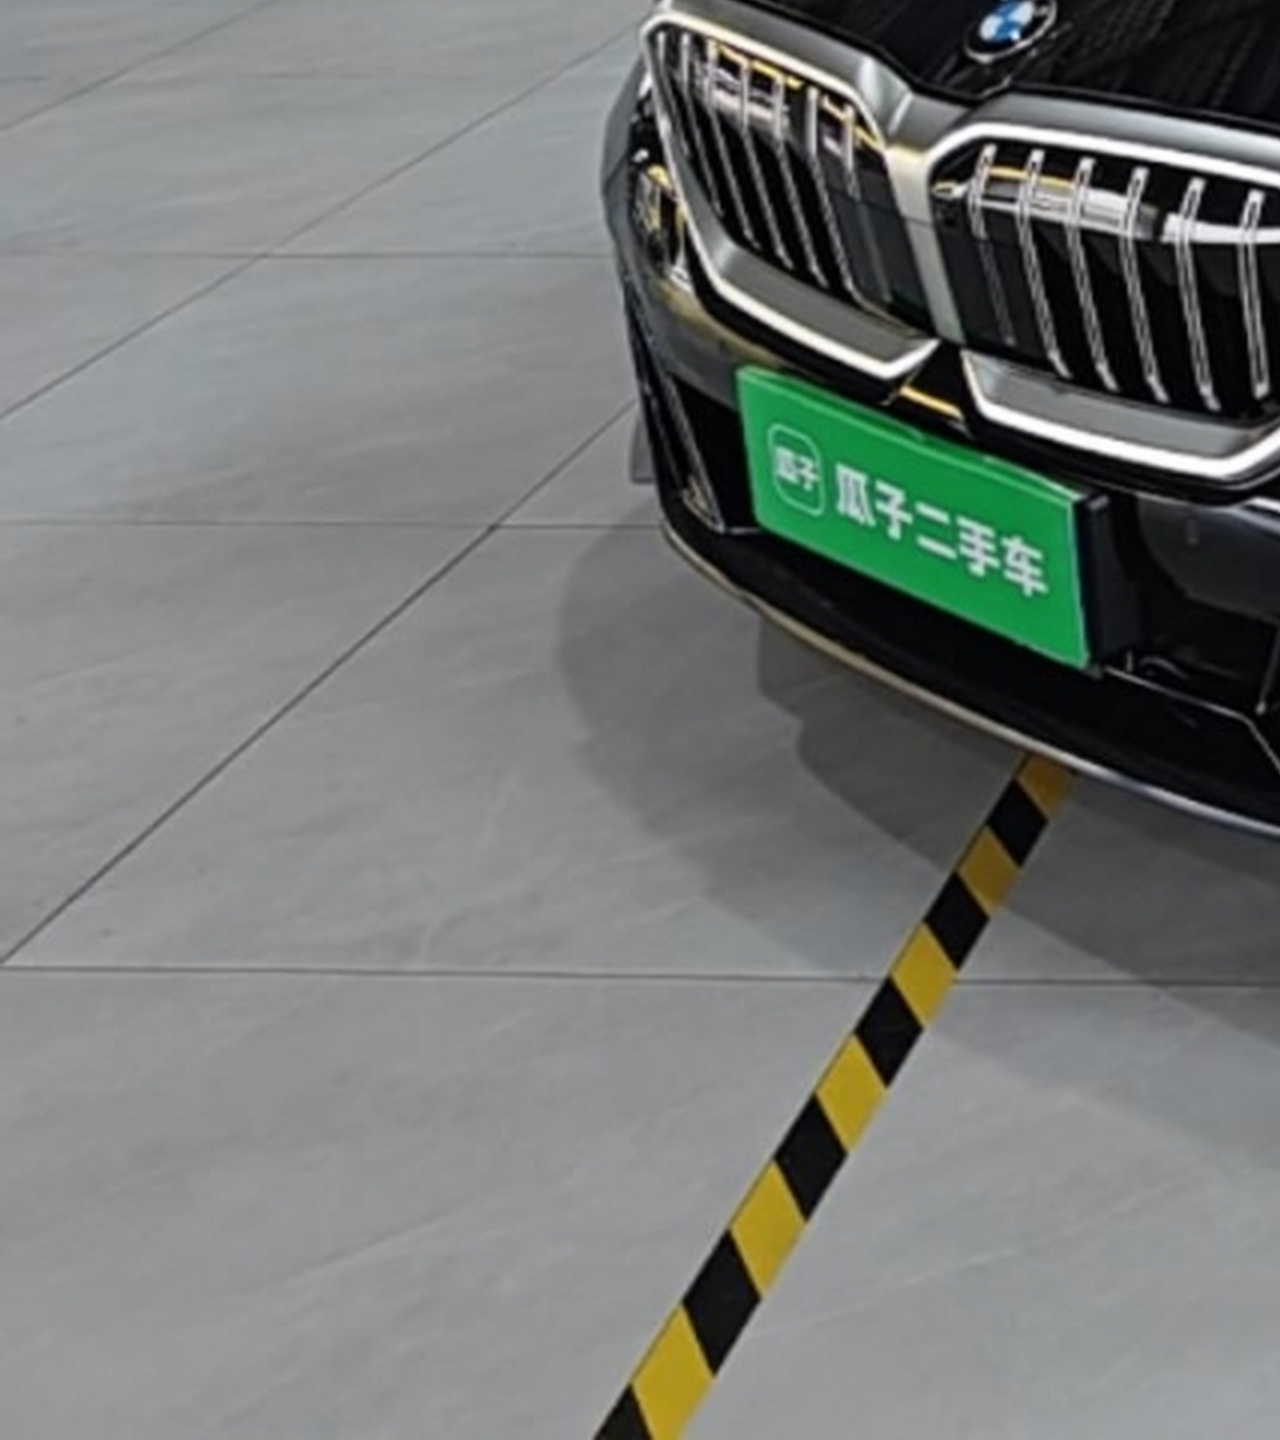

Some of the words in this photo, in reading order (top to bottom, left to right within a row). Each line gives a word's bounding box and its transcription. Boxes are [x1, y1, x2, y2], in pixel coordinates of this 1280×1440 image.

[836, 463, 1048, 597] 瓜子二手车
